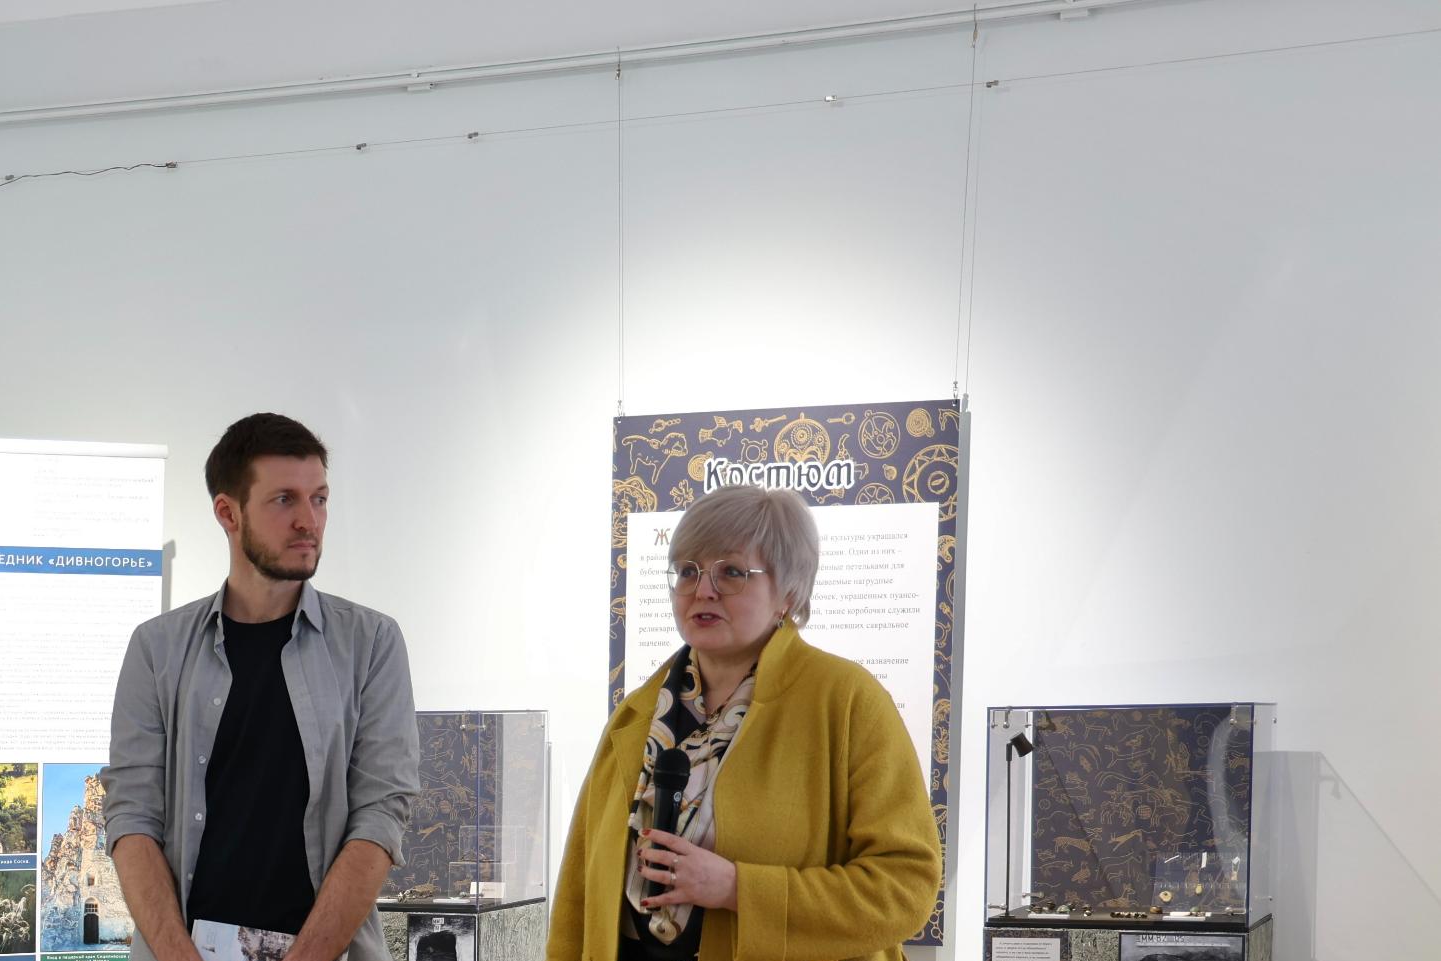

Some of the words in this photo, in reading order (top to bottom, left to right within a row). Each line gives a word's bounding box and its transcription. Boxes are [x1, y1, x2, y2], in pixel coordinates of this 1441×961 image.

[706, 459, 853, 492] Костюм
[48, 556, 153, 568] «ДИВНОГОРЬЕ»
[840, 593, 888, 602] украшенных
[847, 606, 886, 616] коробочки
